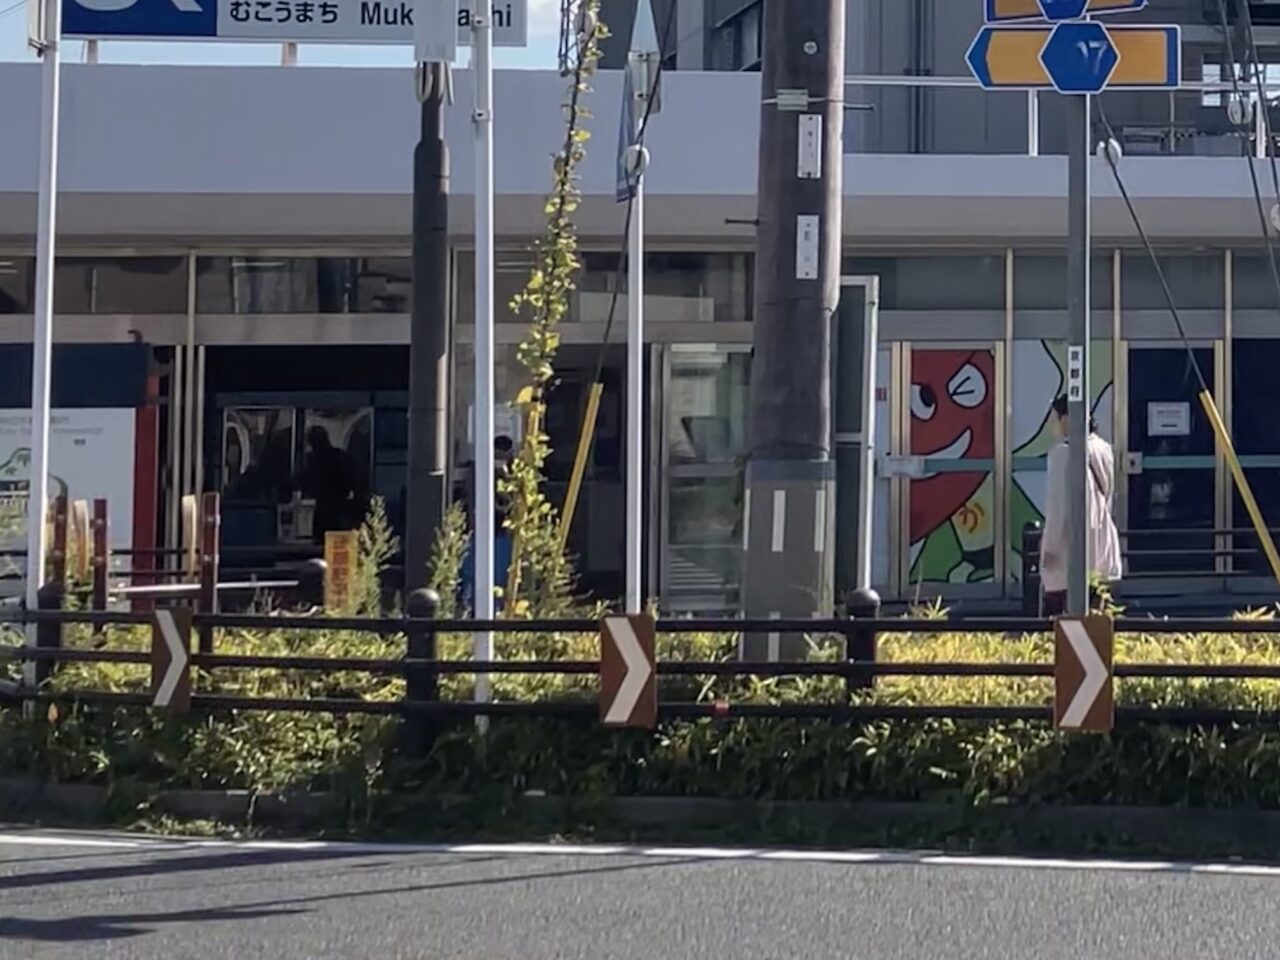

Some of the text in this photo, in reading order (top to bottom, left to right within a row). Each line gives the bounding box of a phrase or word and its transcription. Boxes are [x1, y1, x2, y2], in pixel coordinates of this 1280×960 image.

[229, 1, 339, 24] むこうまち
[361, 1, 512, 28] Mukahi
[959, 501, 985, 534] か
